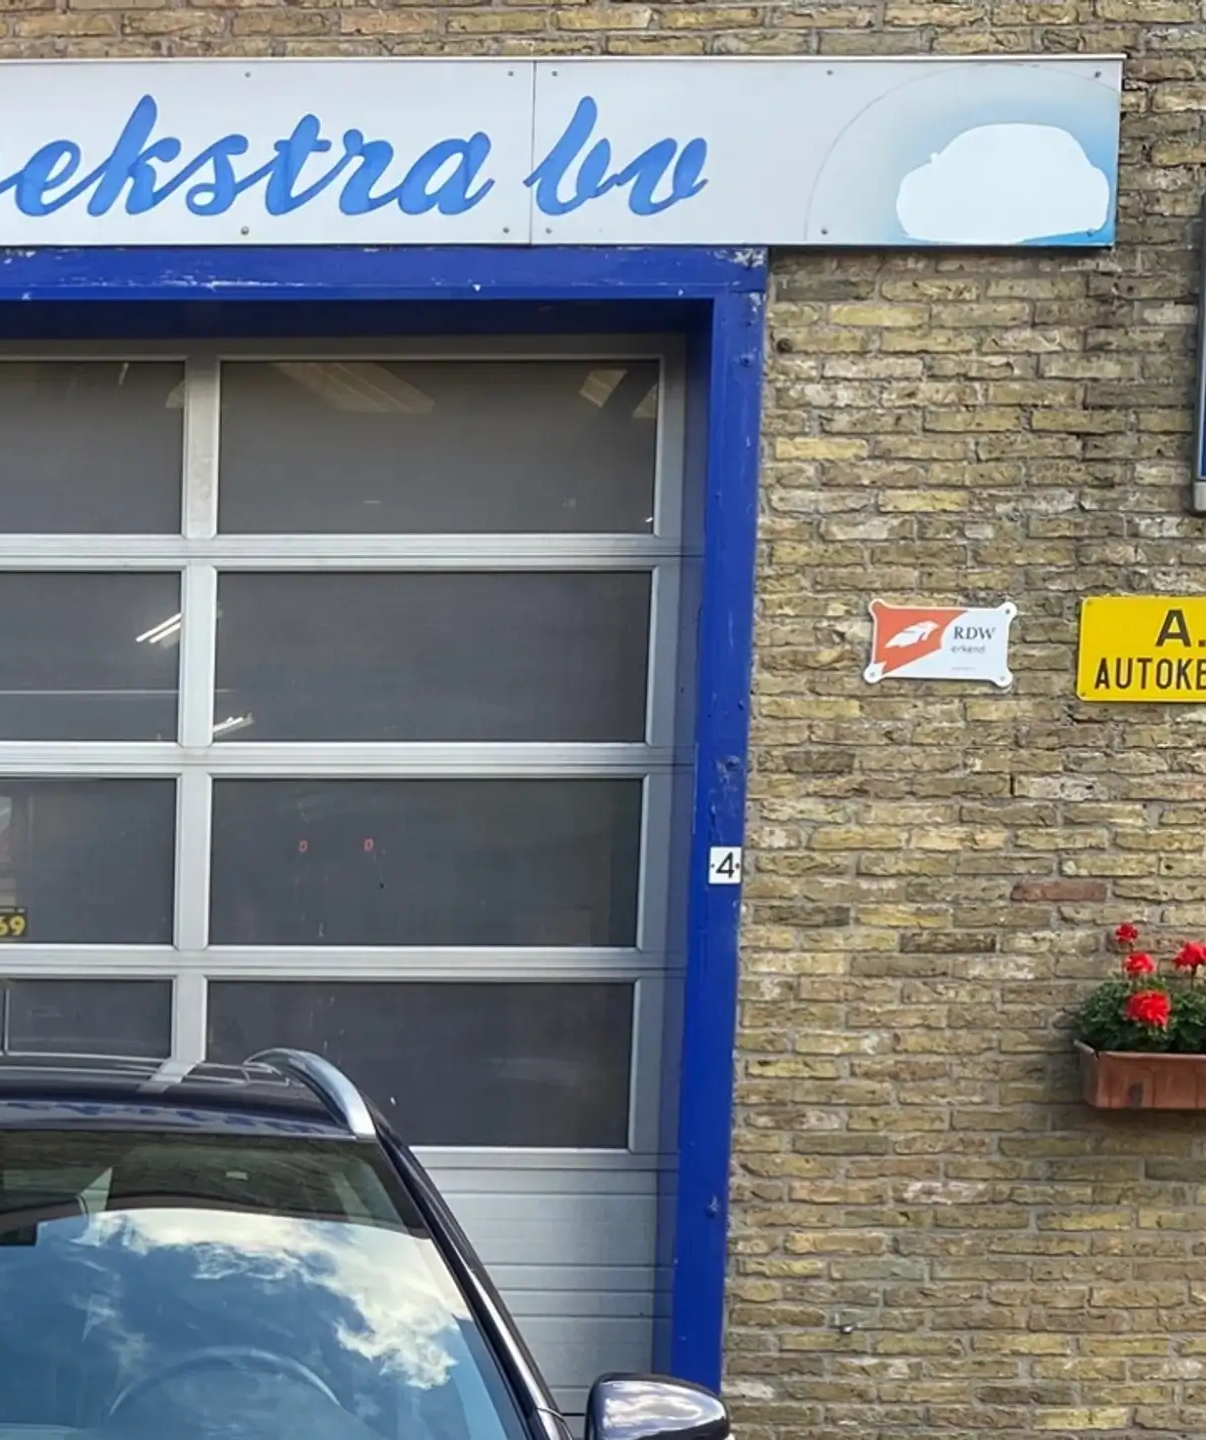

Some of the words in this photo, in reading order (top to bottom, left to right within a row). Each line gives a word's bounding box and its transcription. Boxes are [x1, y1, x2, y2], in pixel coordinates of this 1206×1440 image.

[524, 96, 709, 217] bv
[954, 626, 996, 640] RDW
[716, 852, 735, 878] 4
